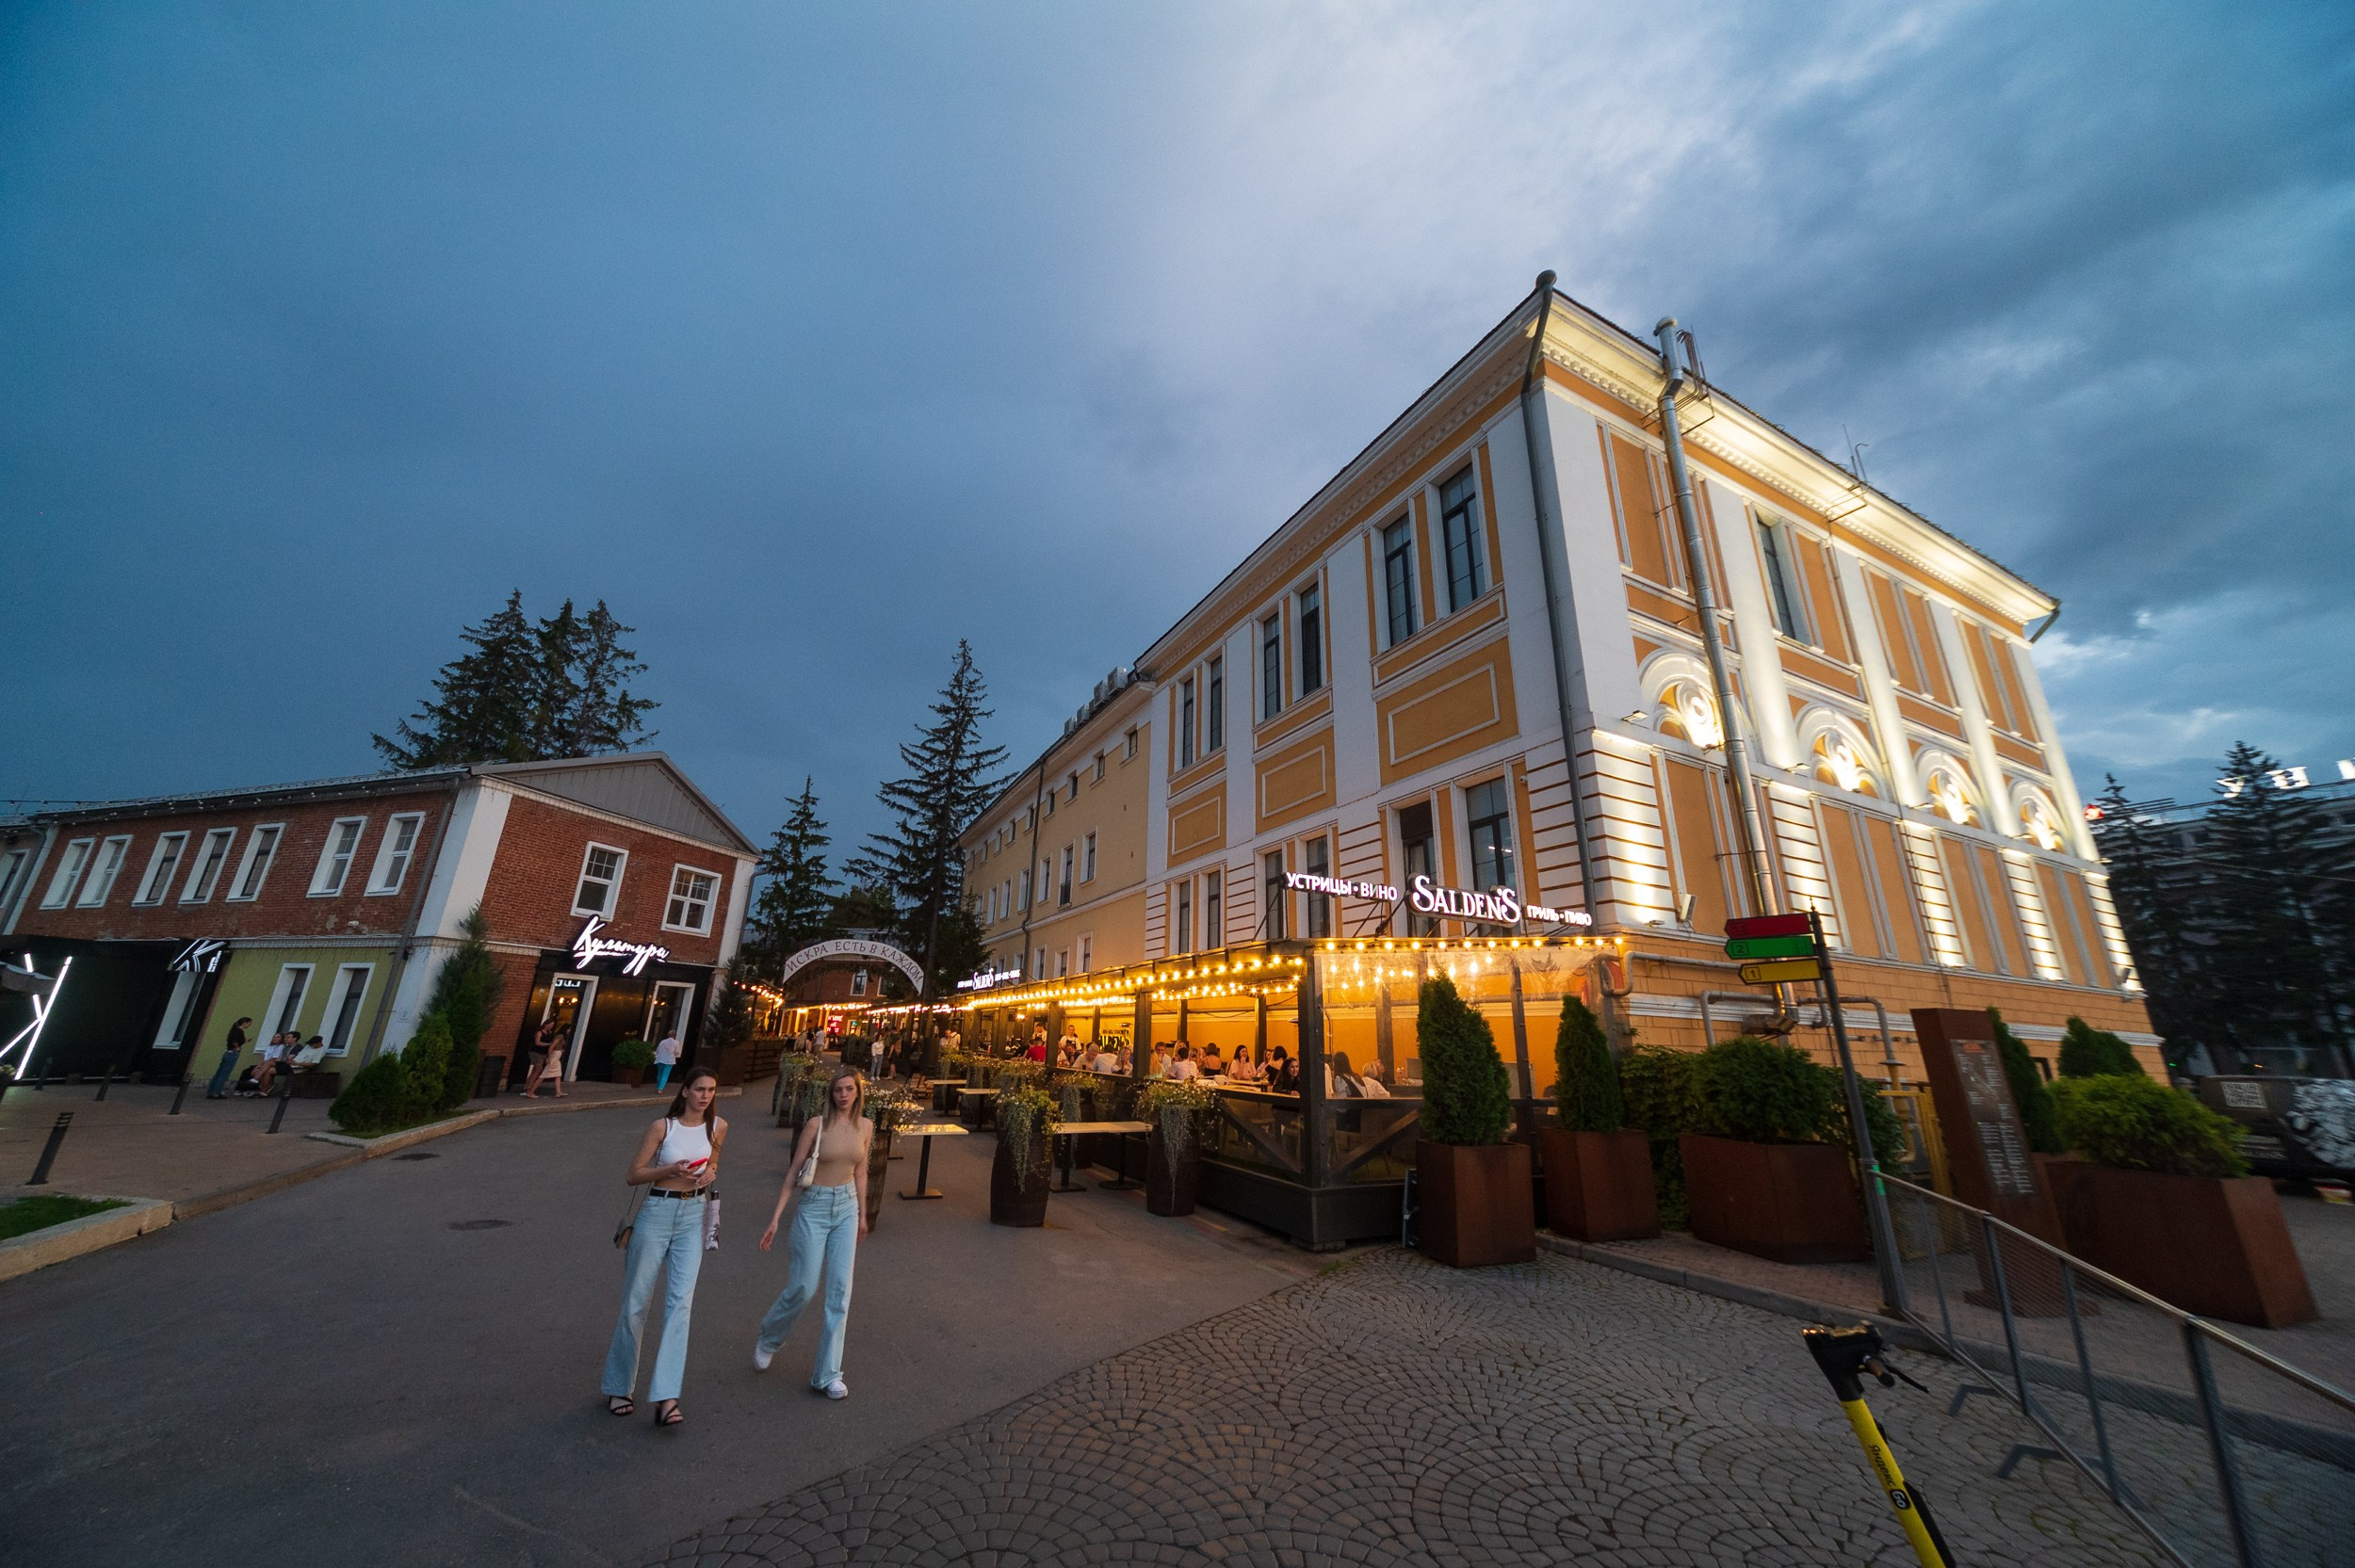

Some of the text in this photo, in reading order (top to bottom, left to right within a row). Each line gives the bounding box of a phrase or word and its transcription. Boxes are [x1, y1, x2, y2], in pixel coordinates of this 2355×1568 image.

[1286, 872, 1398, 901] УСТРИЦЫ ВИНО
[1413, 875, 1520, 923] SALDEN'S
[1527, 905, 1592, 927] ГРИЛЬ ПИВО
[573, 915, 670, 977] Культура
[786, 942, 924, 982] ИСКРА ЕСТЬ В КАЖДОМ
[1869, 1445, 1896, 1486] Яндекс
